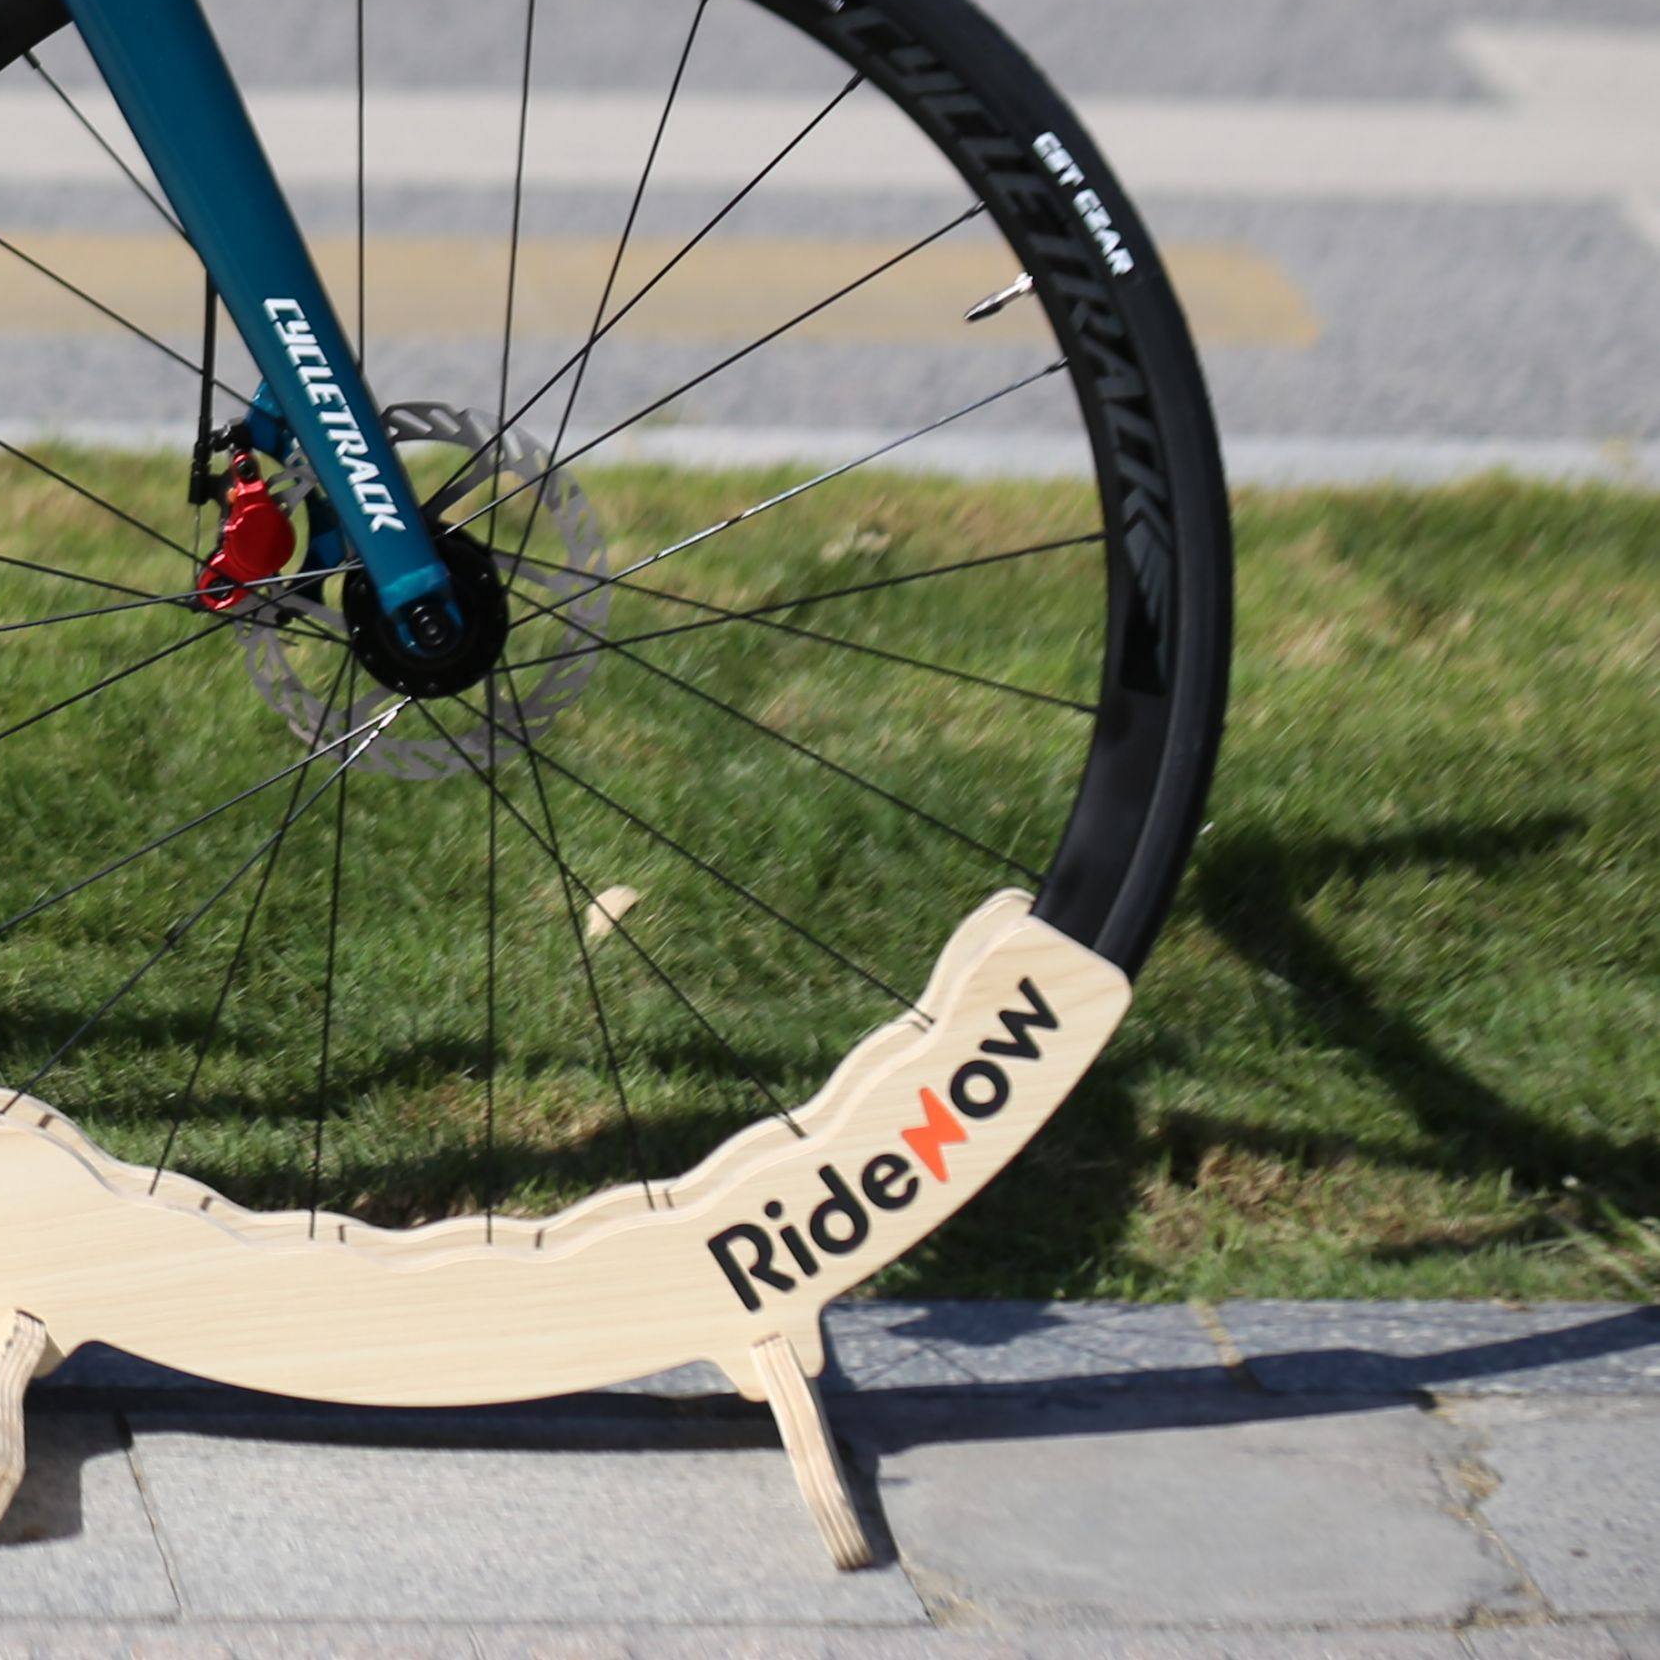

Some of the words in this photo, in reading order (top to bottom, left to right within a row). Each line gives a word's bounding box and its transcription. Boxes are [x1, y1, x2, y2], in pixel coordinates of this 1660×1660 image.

[832, 4, 1175, 549] CYCLETRACK
[1032, 131, 1085, 191] CST
[263, 298, 407, 534] CYCLETRACK
[706, 976, 1059, 1313] RideNow
